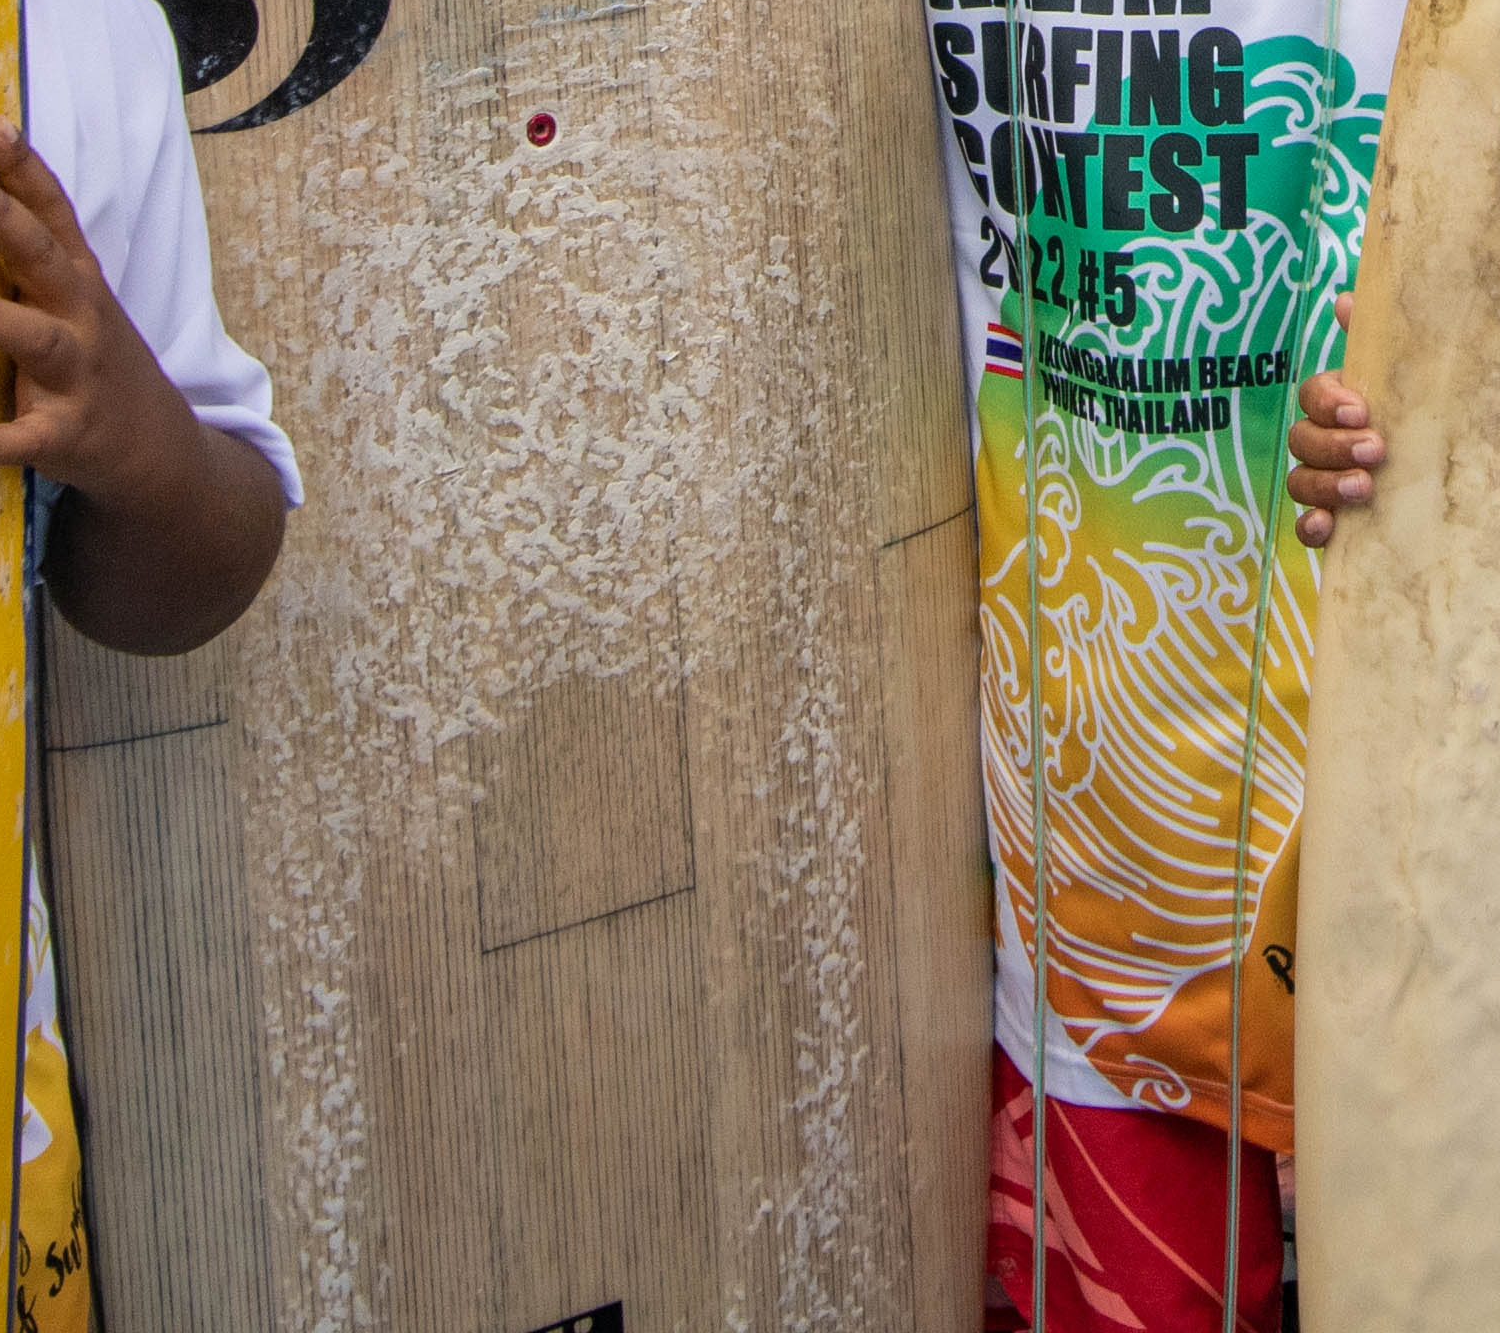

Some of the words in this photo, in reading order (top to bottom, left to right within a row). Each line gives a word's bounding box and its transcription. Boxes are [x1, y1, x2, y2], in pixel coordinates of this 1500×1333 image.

[932, 19, 1246, 129] SURFING
[952, 117, 1260, 233] CONTEST
[1198, 349, 1290, 389] BEACH
[1104, 395, 1232, 435] THAILAND
